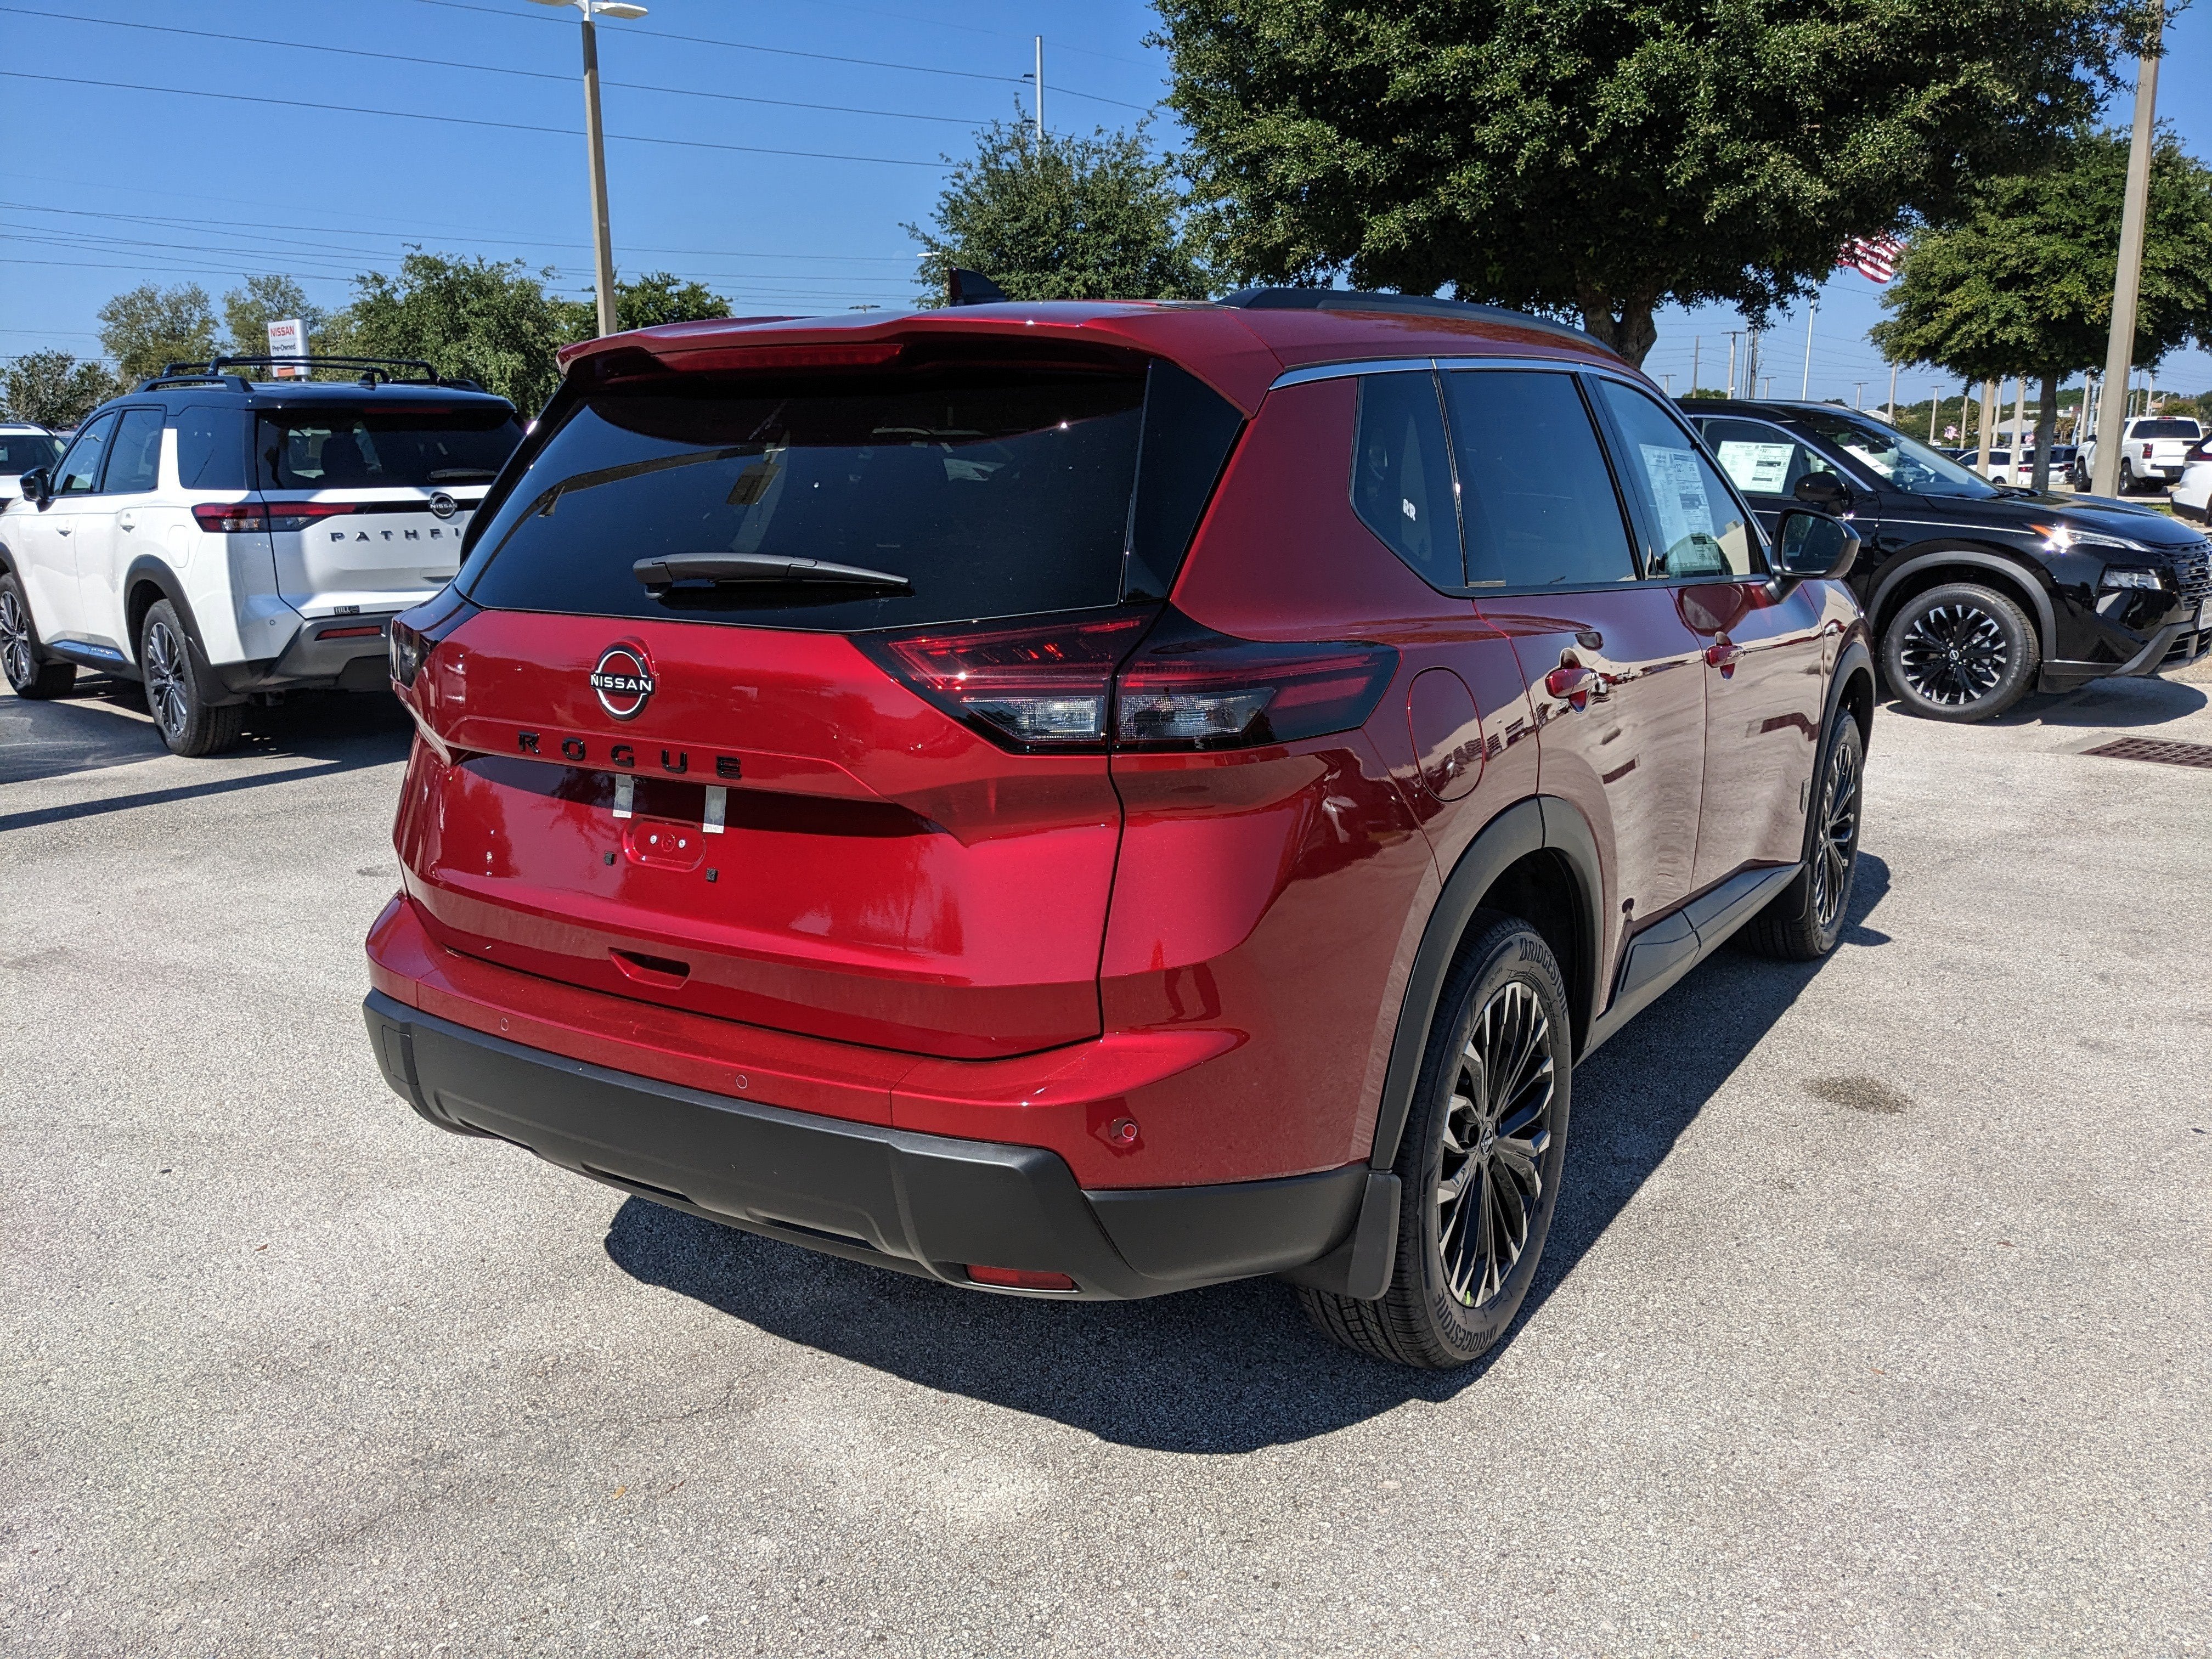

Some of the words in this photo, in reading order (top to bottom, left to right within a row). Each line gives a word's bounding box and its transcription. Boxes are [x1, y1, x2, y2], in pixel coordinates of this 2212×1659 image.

[270, 326, 295, 337] NISSAN
[272, 343, 296, 352] Pre-Owned
[591, 674, 652, 691] NISSAN
[518, 731, 742, 780] ROGUE
[1519, 938, 1568, 1020] BRIDGESTONE
[1433, 1288, 1498, 1352] BRIDGESTONE
